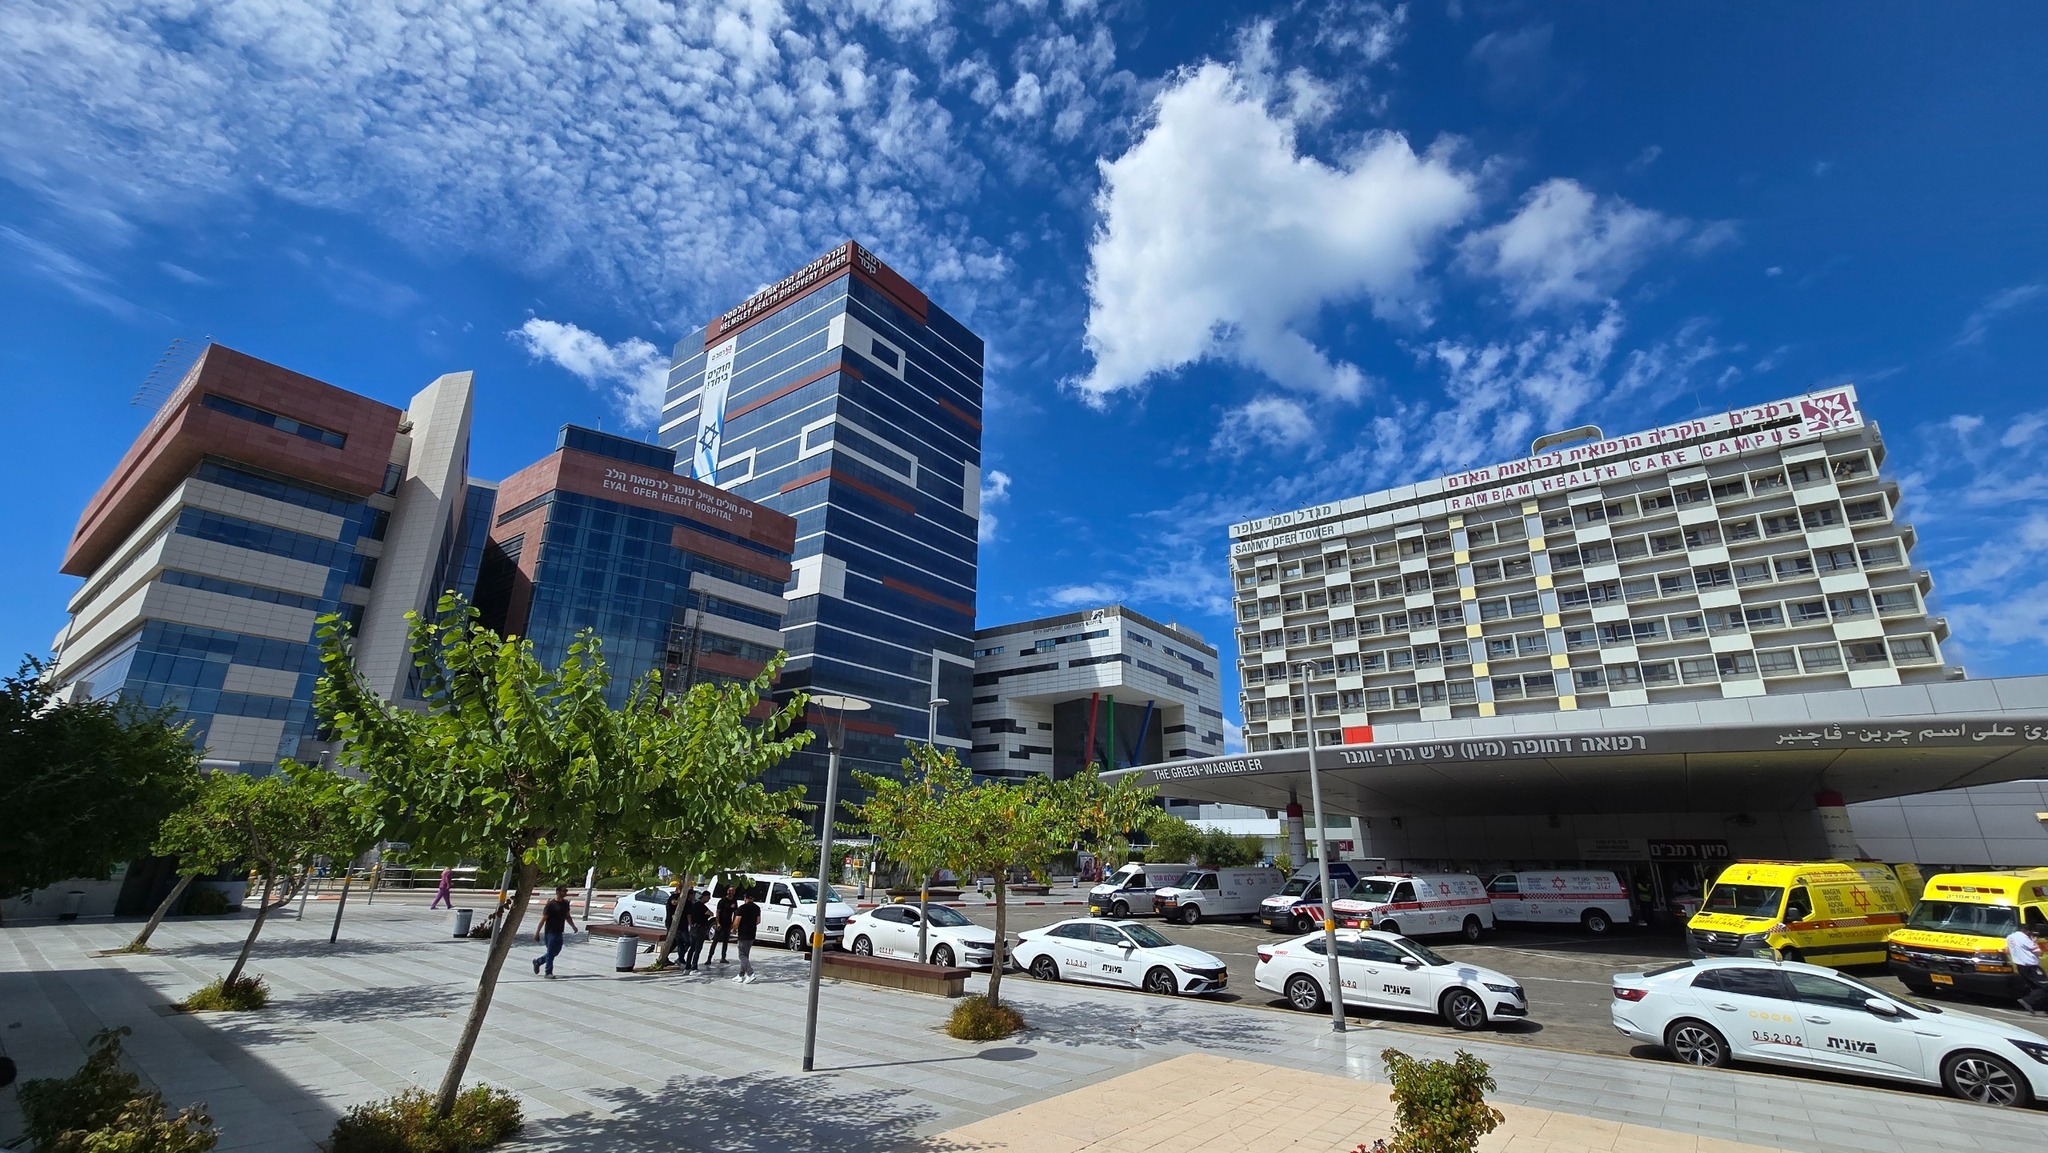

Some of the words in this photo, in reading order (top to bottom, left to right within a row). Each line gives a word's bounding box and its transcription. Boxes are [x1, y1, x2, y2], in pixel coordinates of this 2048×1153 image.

[826, 245, 846, 262] מגדל
[858, 245, 882, 269] רמבם
[796, 260, 822, 276] תגליות
[720, 308, 752, 332] HELMSLEY
[753, 293, 778, 314] HEALTH
[779, 270, 818, 298] DISCOVERY
[820, 254, 846, 273] TOWER
[764, 276, 794, 298] הבריאות
[721, 303, 746, 322] הלמסלי
[708, 362, 731, 379] חזקים
[1648, 420, 1706, 444] הקריה
[1570, 434, 1642, 462] הרפואית
[1452, 484, 1530, 509] RAMBAM
[1542, 466, 1617, 490] HEALTH
[1631, 451, 1686, 472] CARE
[1702, 427, 1800, 457] CAMPUS
[1498, 451, 1562, 478] לבריאות
[605, 468, 626, 480] הלב
[628, 474, 668, 490] לרפואת
[1448, 469, 1490, 488] האדם
[672, 484, 695, 497] עופר
[698, 489, 714, 504] אייל
[603, 480, 628, 492] EYAL
[632, 487, 658, 499] OFER
[662, 493, 693, 507] HEART
[695, 502, 733, 522] HOSPITAL
[716, 497, 738, 513] חולים
[739, 507, 753, 519] בית
[1268, 515, 1291, 527] סמי
[1297, 505, 1332, 520] מגדל
[1233, 522, 1263, 534] עופר
[1235, 539, 1270, 554] SAMMY
[1273, 533, 1297, 546] OFER
[1299, 525, 1334, 540] TOWER
[1918, 723, 1966, 742] اسم
[1972, 722, 2016, 742] على
[1461, 739, 1507, 761] (מיון)
[1512, 737, 1572, 755] דחופה
[1580, 734, 1647, 753] רפואה
[1153, 769, 1170, 780] THE
[1171, 760, 1247, 779] GREEN-WAGNER
[1247, 758, 1263, 771] ER
[1650, 844, 1696, 856] רמב"ם
[1701, 844, 1728, 859] מיון
[1693, 919, 1746, 929] AMBULANCE
[1906, 936, 1974, 946] AMBULANCE
[1102, 964, 1122, 973] מונית
[1383, 984, 1411, 995] מונית
[1826, 1037, 1877, 1054] מונית
